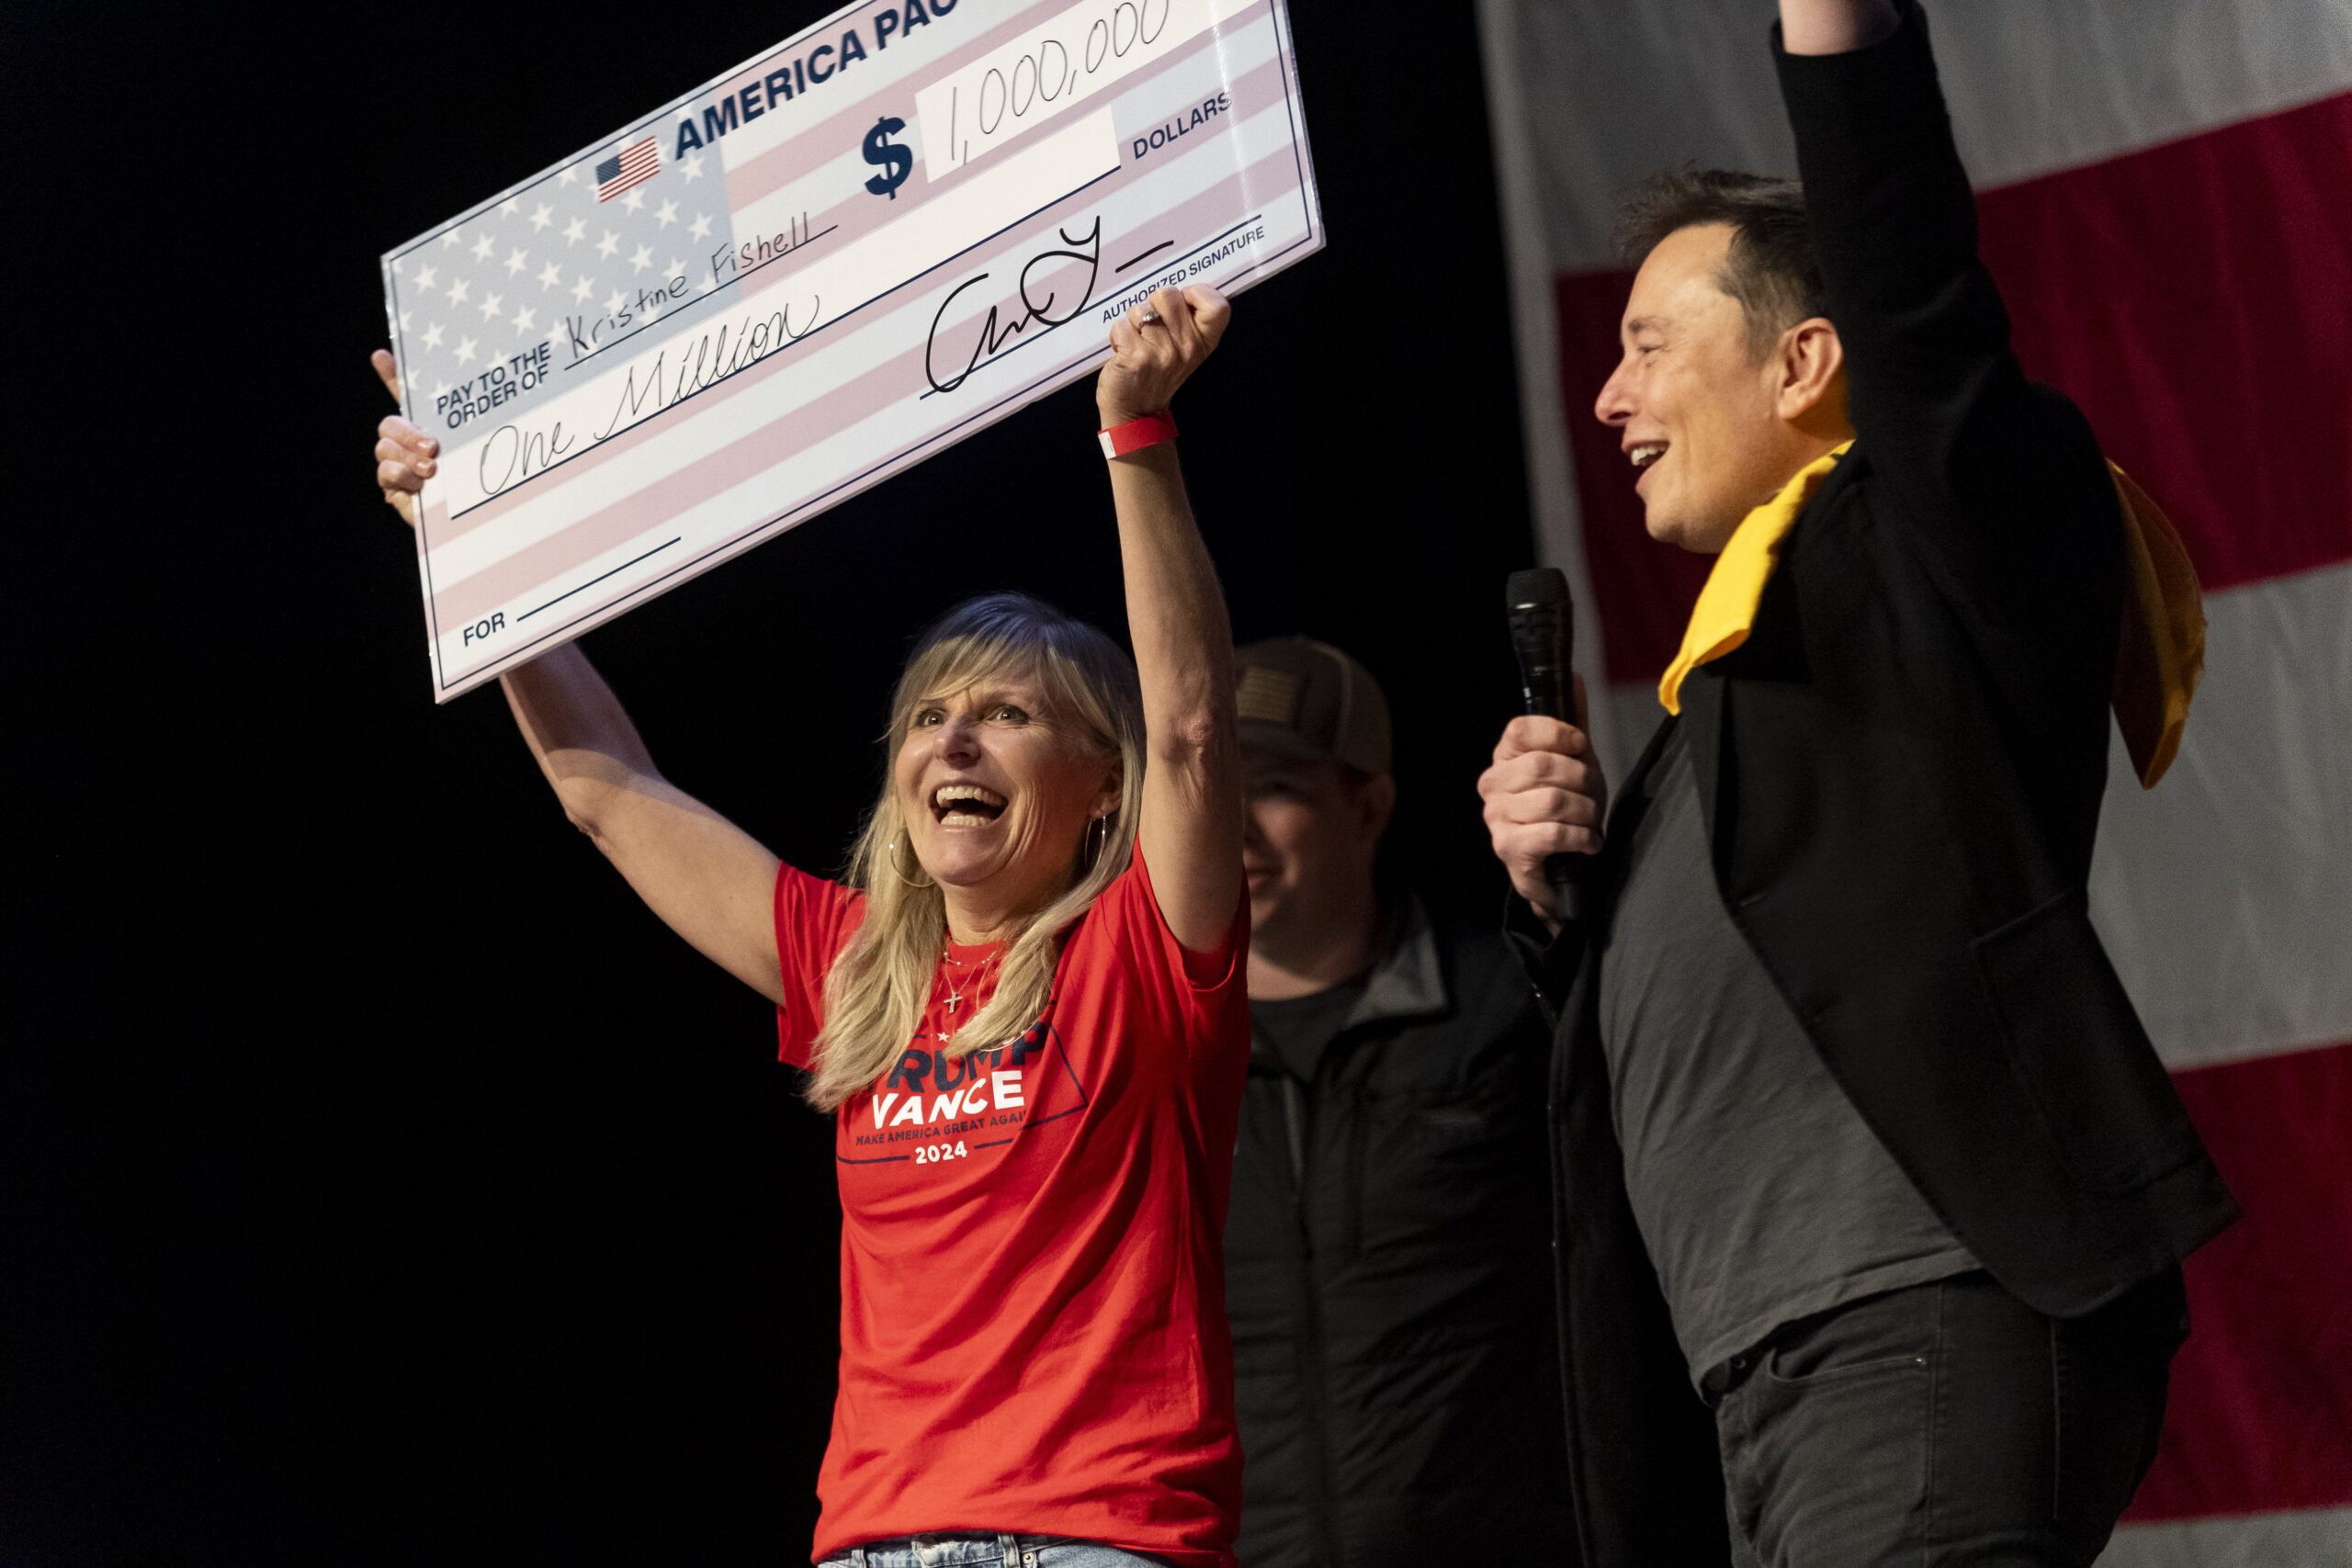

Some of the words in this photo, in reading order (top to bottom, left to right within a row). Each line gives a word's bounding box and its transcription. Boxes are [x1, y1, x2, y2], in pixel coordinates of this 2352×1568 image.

[675, 28, 867, 160] AMERICA
[951, 0, 1169, 165] 1,000,000
[861, 116, 913, 200] $
[1132, 92, 1232, 161] DOLLARS
[566, 276, 689, 359] Kristine
[711, 211, 808, 284] Fishell
[1189, 226, 1265, 276] SIGNATURE
[436, 380, 473, 415] PAY
[478, 366, 505, 391] TO
[509, 341, 551, 376] THE
[447, 380, 517, 429] ORDER
[521, 363, 548, 390] OF
[480, 422, 575, 495] One
[594, 294, 820, 441] Million
[463, 612, 505, 647] FOR
[887, 1021, 1048, 1093] RUMP
[855, 1134, 885, 1146] MAKE
[888, 1126, 941, 1143] AMERICA
[944, 1119, 986, 1136] GREAT
[872, 1070, 1025, 1130] VANCE
[914, 1140, 968, 1165] 2024
